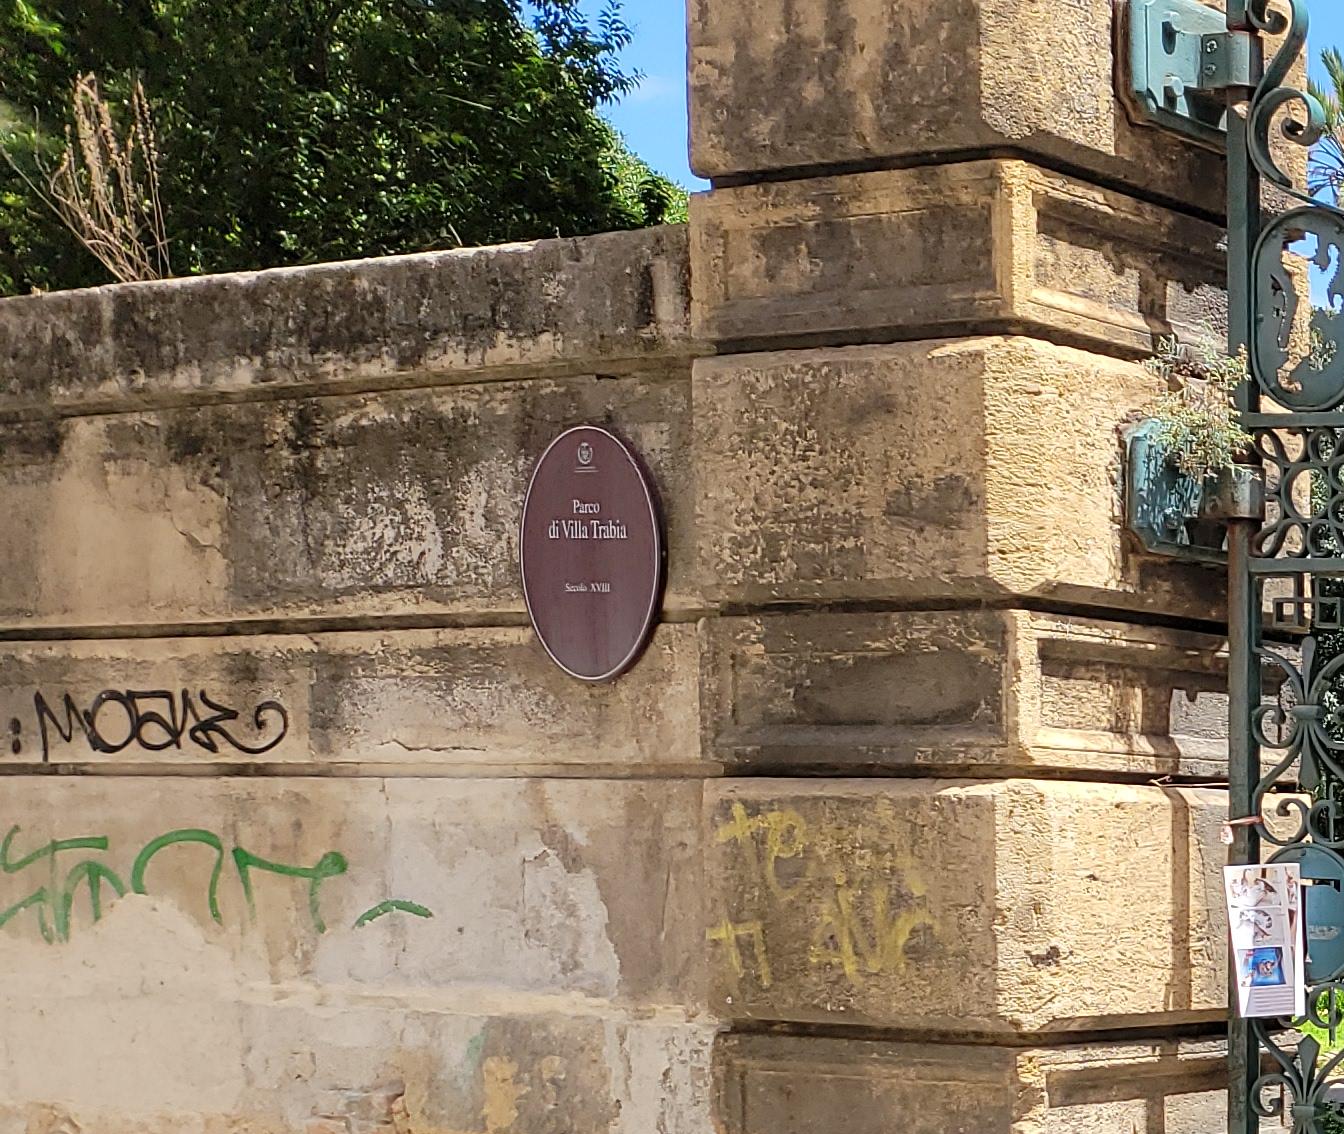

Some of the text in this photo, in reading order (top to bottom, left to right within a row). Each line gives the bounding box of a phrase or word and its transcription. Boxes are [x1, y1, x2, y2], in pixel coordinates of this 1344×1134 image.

[573, 500, 600, 514] Parco
[549, 520, 627, 539] di Villa Trabia
[565, 583, 610, 593] Secolo XVIII
